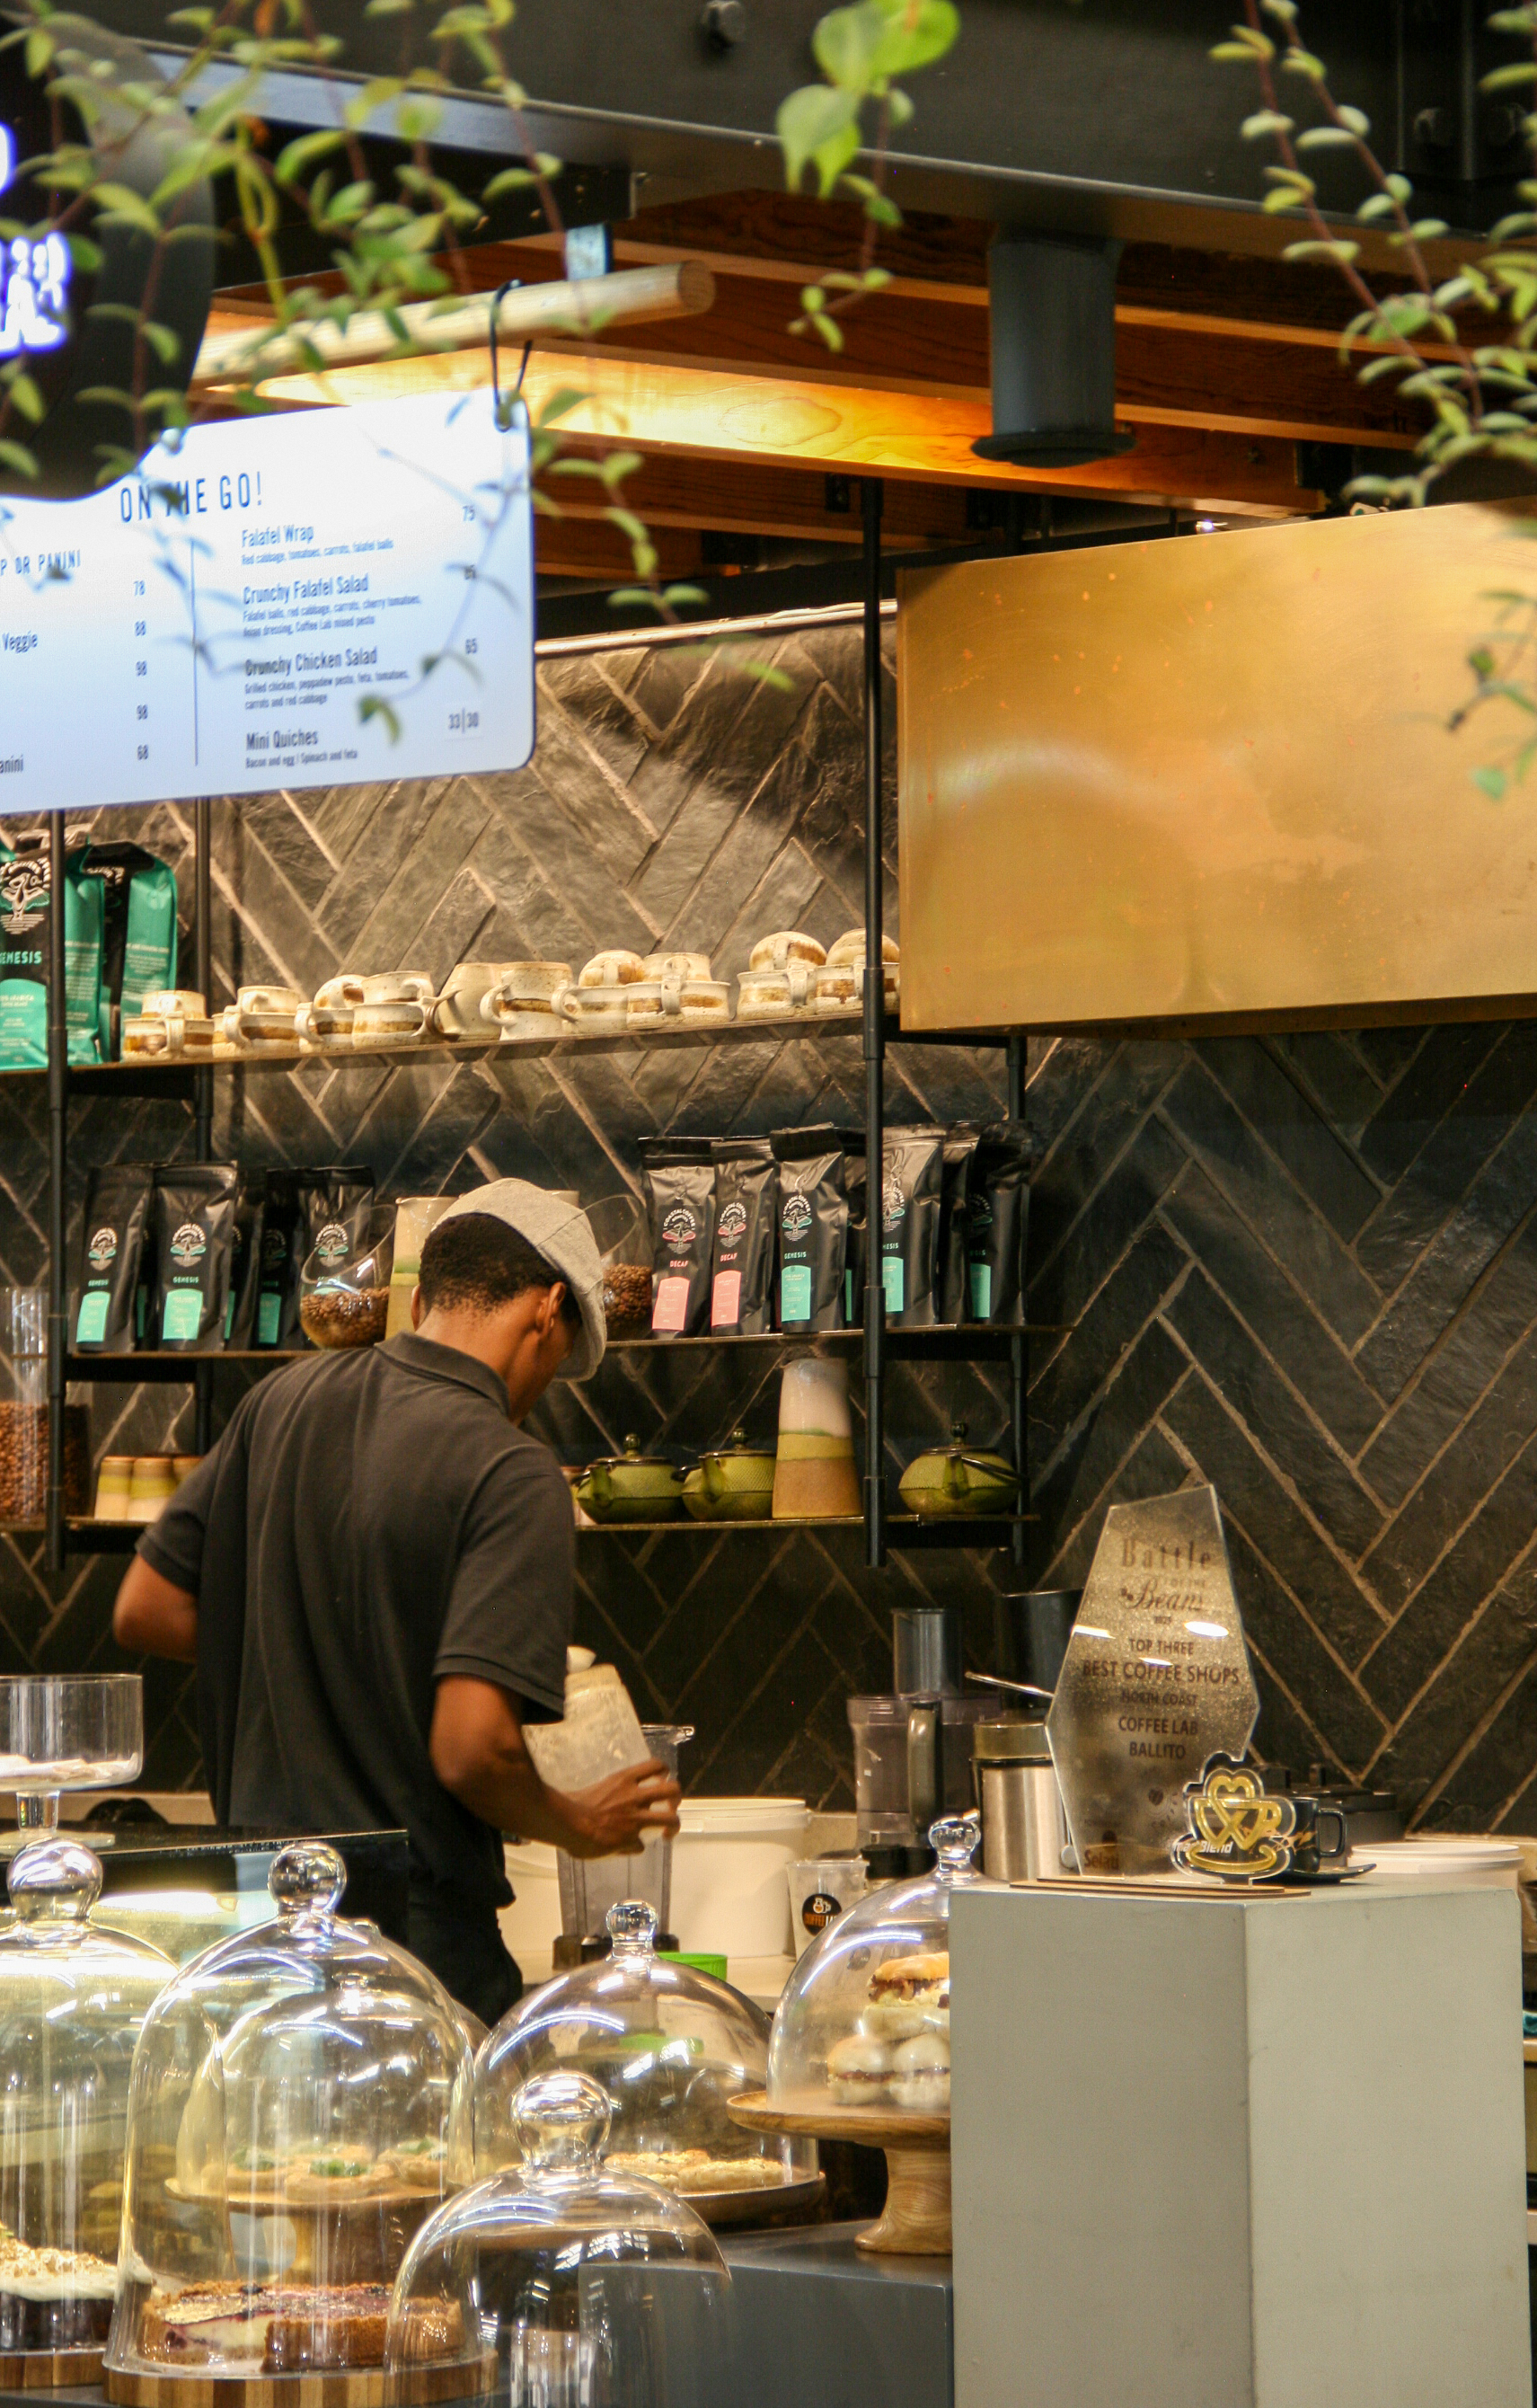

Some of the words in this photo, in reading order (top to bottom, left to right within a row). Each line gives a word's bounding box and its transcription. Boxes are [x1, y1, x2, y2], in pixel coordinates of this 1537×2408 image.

[120, 484, 152, 523] ON
[219, 471, 262, 510] GO!
[463, 505, 475, 521] 75
[242, 526, 280, 547] Falafel
[283, 524, 314, 544] Wrap
[15, 555, 31, 574] OR
[243, 582, 290, 605] Crunchy
[294, 577, 332, 599] Falafel
[337, 572, 368, 594] Salad
[2, 631, 38, 653] Veggie
[245, 656, 292, 677] Crunchy
[296, 651, 342, 671] Chicken
[345, 645, 377, 667] Salad
[246, 730, 269, 751] Mini
[273, 728, 319, 748] Quiches
[669, 1260, 689, 1268] DECAF
[720, 1253, 738, 1262] DECAF
[784, 1252, 807, 1260] GENESIS
[1122, 1539, 1211, 1570] Battle
[1129, 1638, 1153, 1652] TOP
[1157, 1640, 1194, 1655] THREE
[1082, 1660, 1117, 1678] BEST
[1123, 1662, 1182, 1682] COFFEE
[1187, 1665, 1240, 1685] SHOPS
[1162, 1693, 1197, 1706] COAST
[1118, 1716, 1168, 1733] COFFEE
[1171, 1720, 1198, 1735] LAB
[1129, 1741, 1186, 1760] BALLITO
